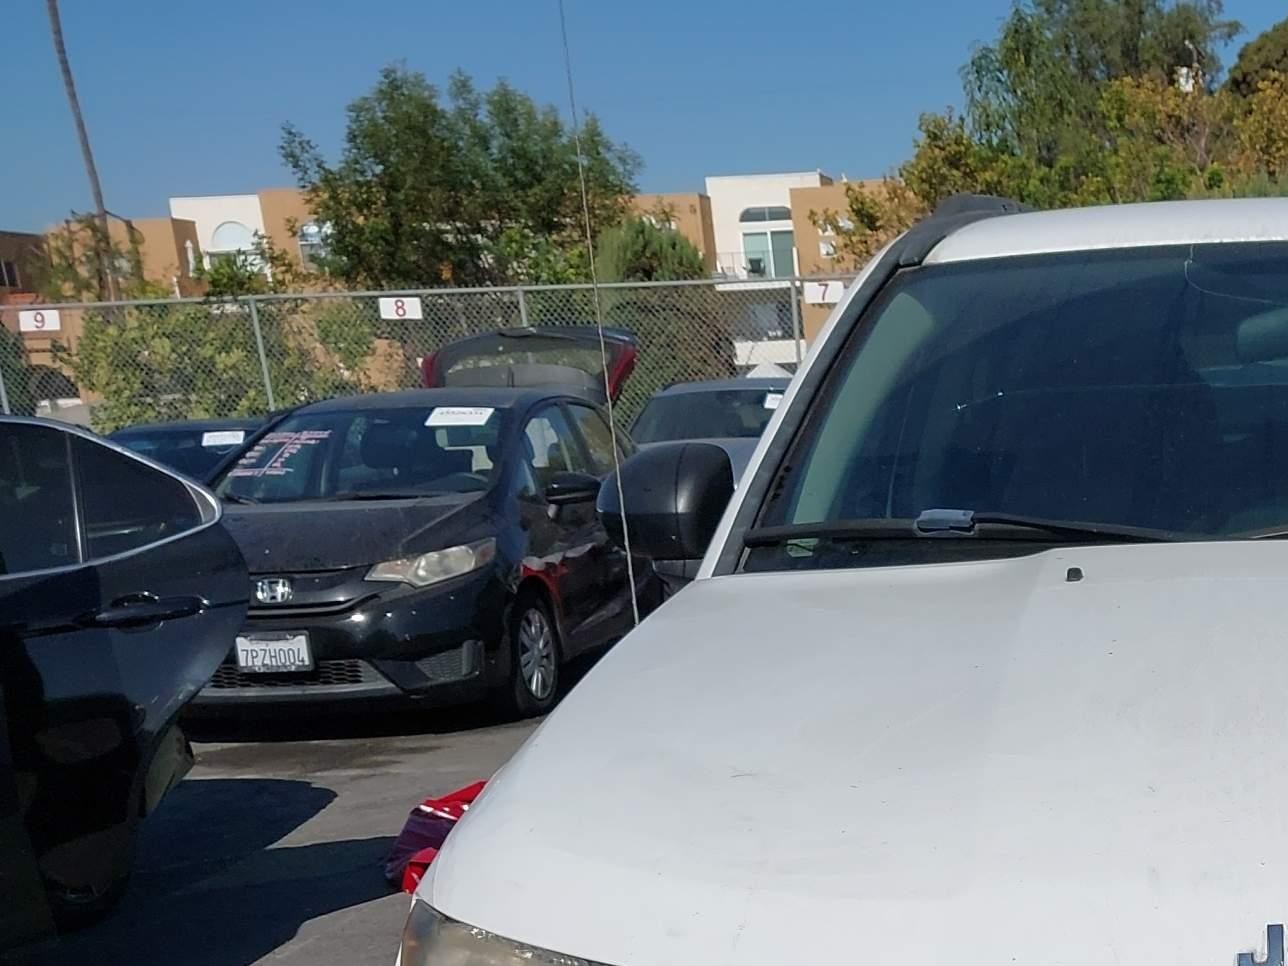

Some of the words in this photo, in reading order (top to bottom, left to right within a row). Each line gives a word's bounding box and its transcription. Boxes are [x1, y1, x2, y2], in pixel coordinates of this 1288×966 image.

[818, 282, 829, 301] 7
[394, 299, 406, 317] 8
[34, 311, 45, 329] 9
[240, 647, 305, 667] 7PZH004
